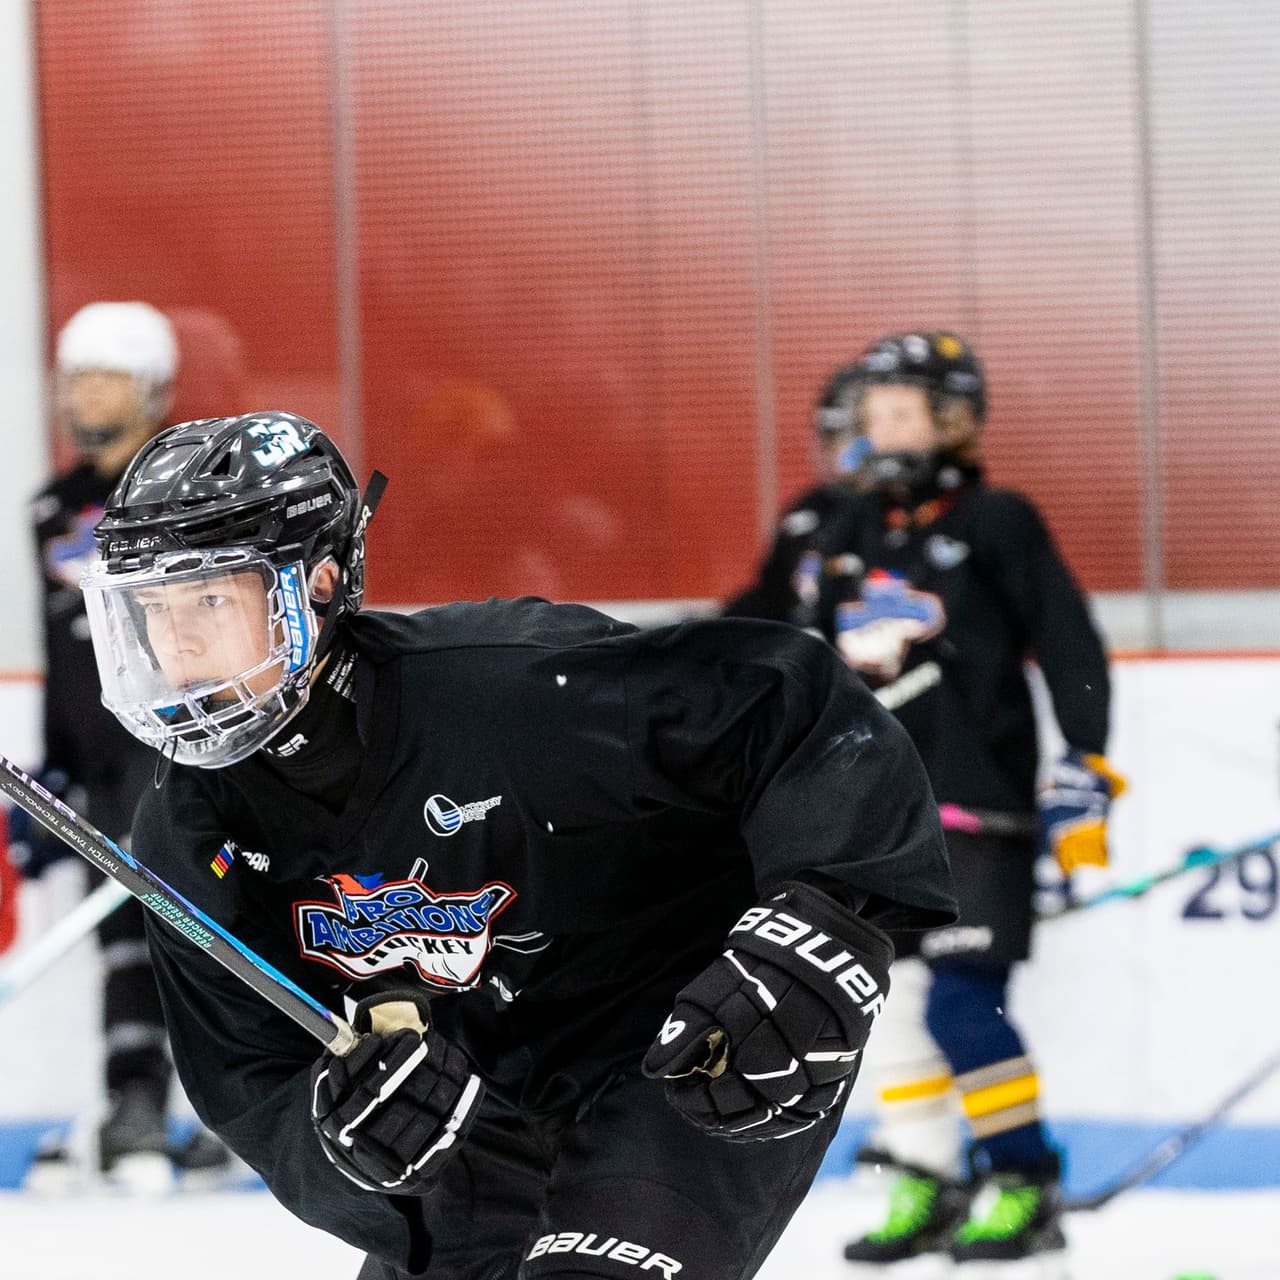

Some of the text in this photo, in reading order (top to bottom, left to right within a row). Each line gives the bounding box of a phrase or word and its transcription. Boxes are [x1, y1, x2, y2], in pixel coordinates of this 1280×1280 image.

[279, 568, 304, 666] BAUER
[6, 781, 120, 874] TWITCH TAPER TECHNOLOGY
[1180, 848, 1280, 921] 29
[173, 919, 213, 949] REACTIVE
[182, 916, 215, 941] LANCER
